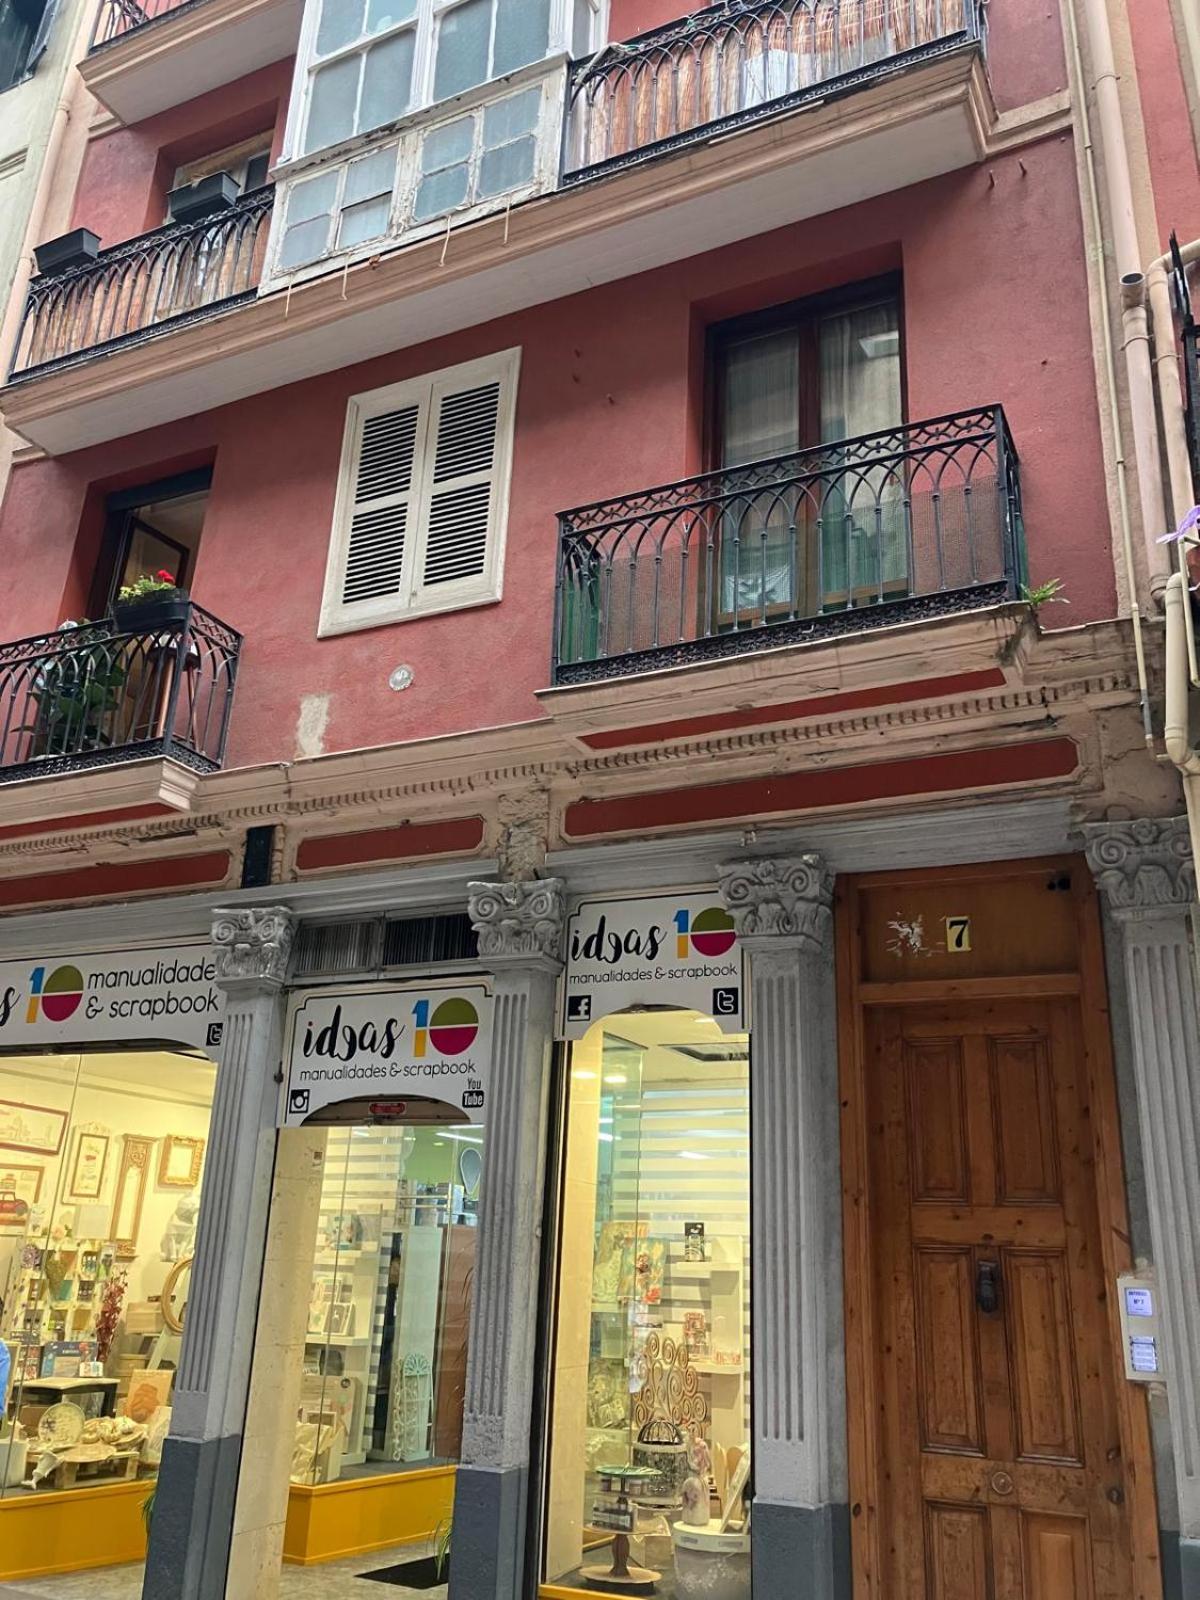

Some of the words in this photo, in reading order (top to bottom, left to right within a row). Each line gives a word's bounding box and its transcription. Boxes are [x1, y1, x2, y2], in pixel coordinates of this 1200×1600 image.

[571, 915, 668, 964] ideas
[673, 907, 736, 959] 10
[948, 919, 969, 948] 7
[87, 956, 216, 990] manualidade
[569, 967, 652, 984] manualidades
[654, 966, 667, 980] &
[667, 962, 738, 980] scrapbook
[25, 965, 84, 1023] 10
[86, 995, 104, 1019] &
[109, 987, 219, 1020] scrapbook
[302, 1004, 405, 1062] ideas
[411, 997, 479, 1057] 10
[300, 1064, 387, 1082] manualidades
[389, 1062, 401, 1077] &
[402, 1060, 477, 1079] scrapbook
[467, 1078, 482, 1090] You
[463, 1091, 484, 1107] Tube
